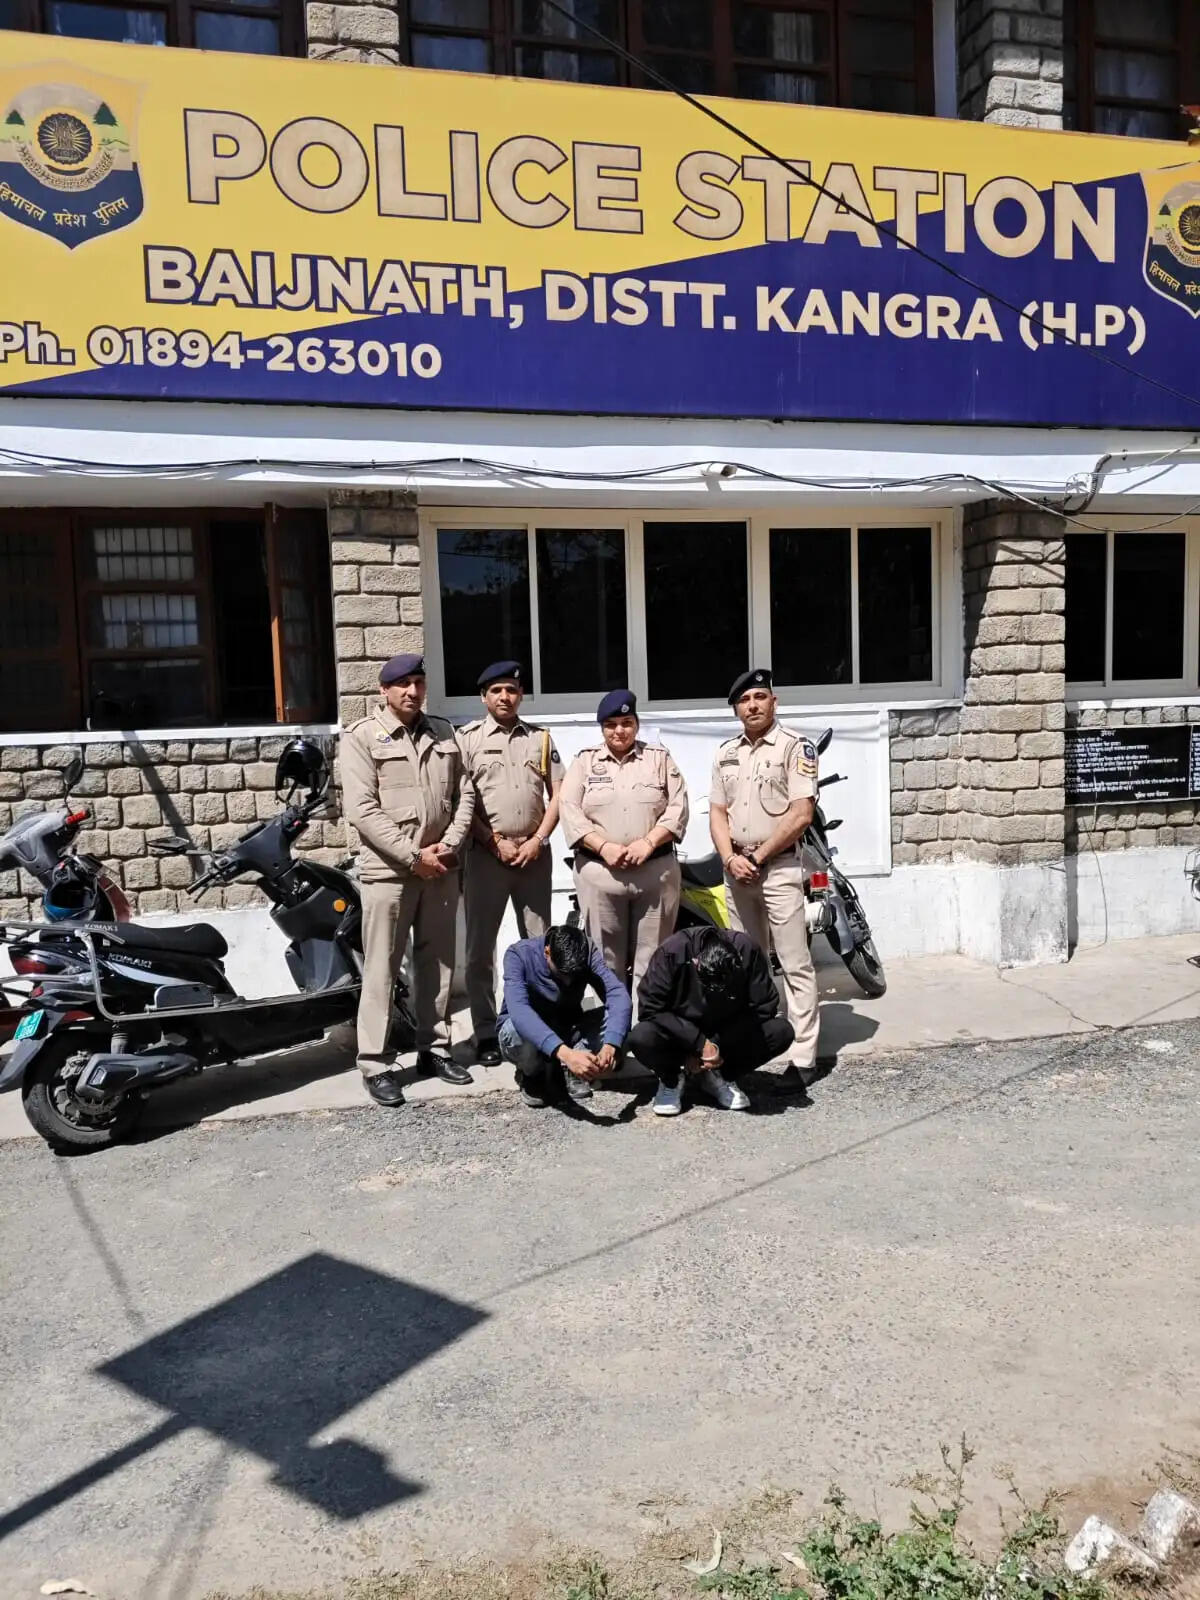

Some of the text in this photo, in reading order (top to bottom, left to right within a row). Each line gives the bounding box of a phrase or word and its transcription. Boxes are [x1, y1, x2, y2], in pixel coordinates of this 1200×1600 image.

[53, 208, 87, 228] प्रदेश
[92, 197, 129, 226] पुलिस
[183, 107, 1117, 264] POLICE STATION
[143, 244, 1148, 356] BAIJNATH, DISTT. KANGRA (H.P)
[1149, 260, 1181, 293] हिमाचल
[0, 320, 443, 379] Ph. 01894-263010
